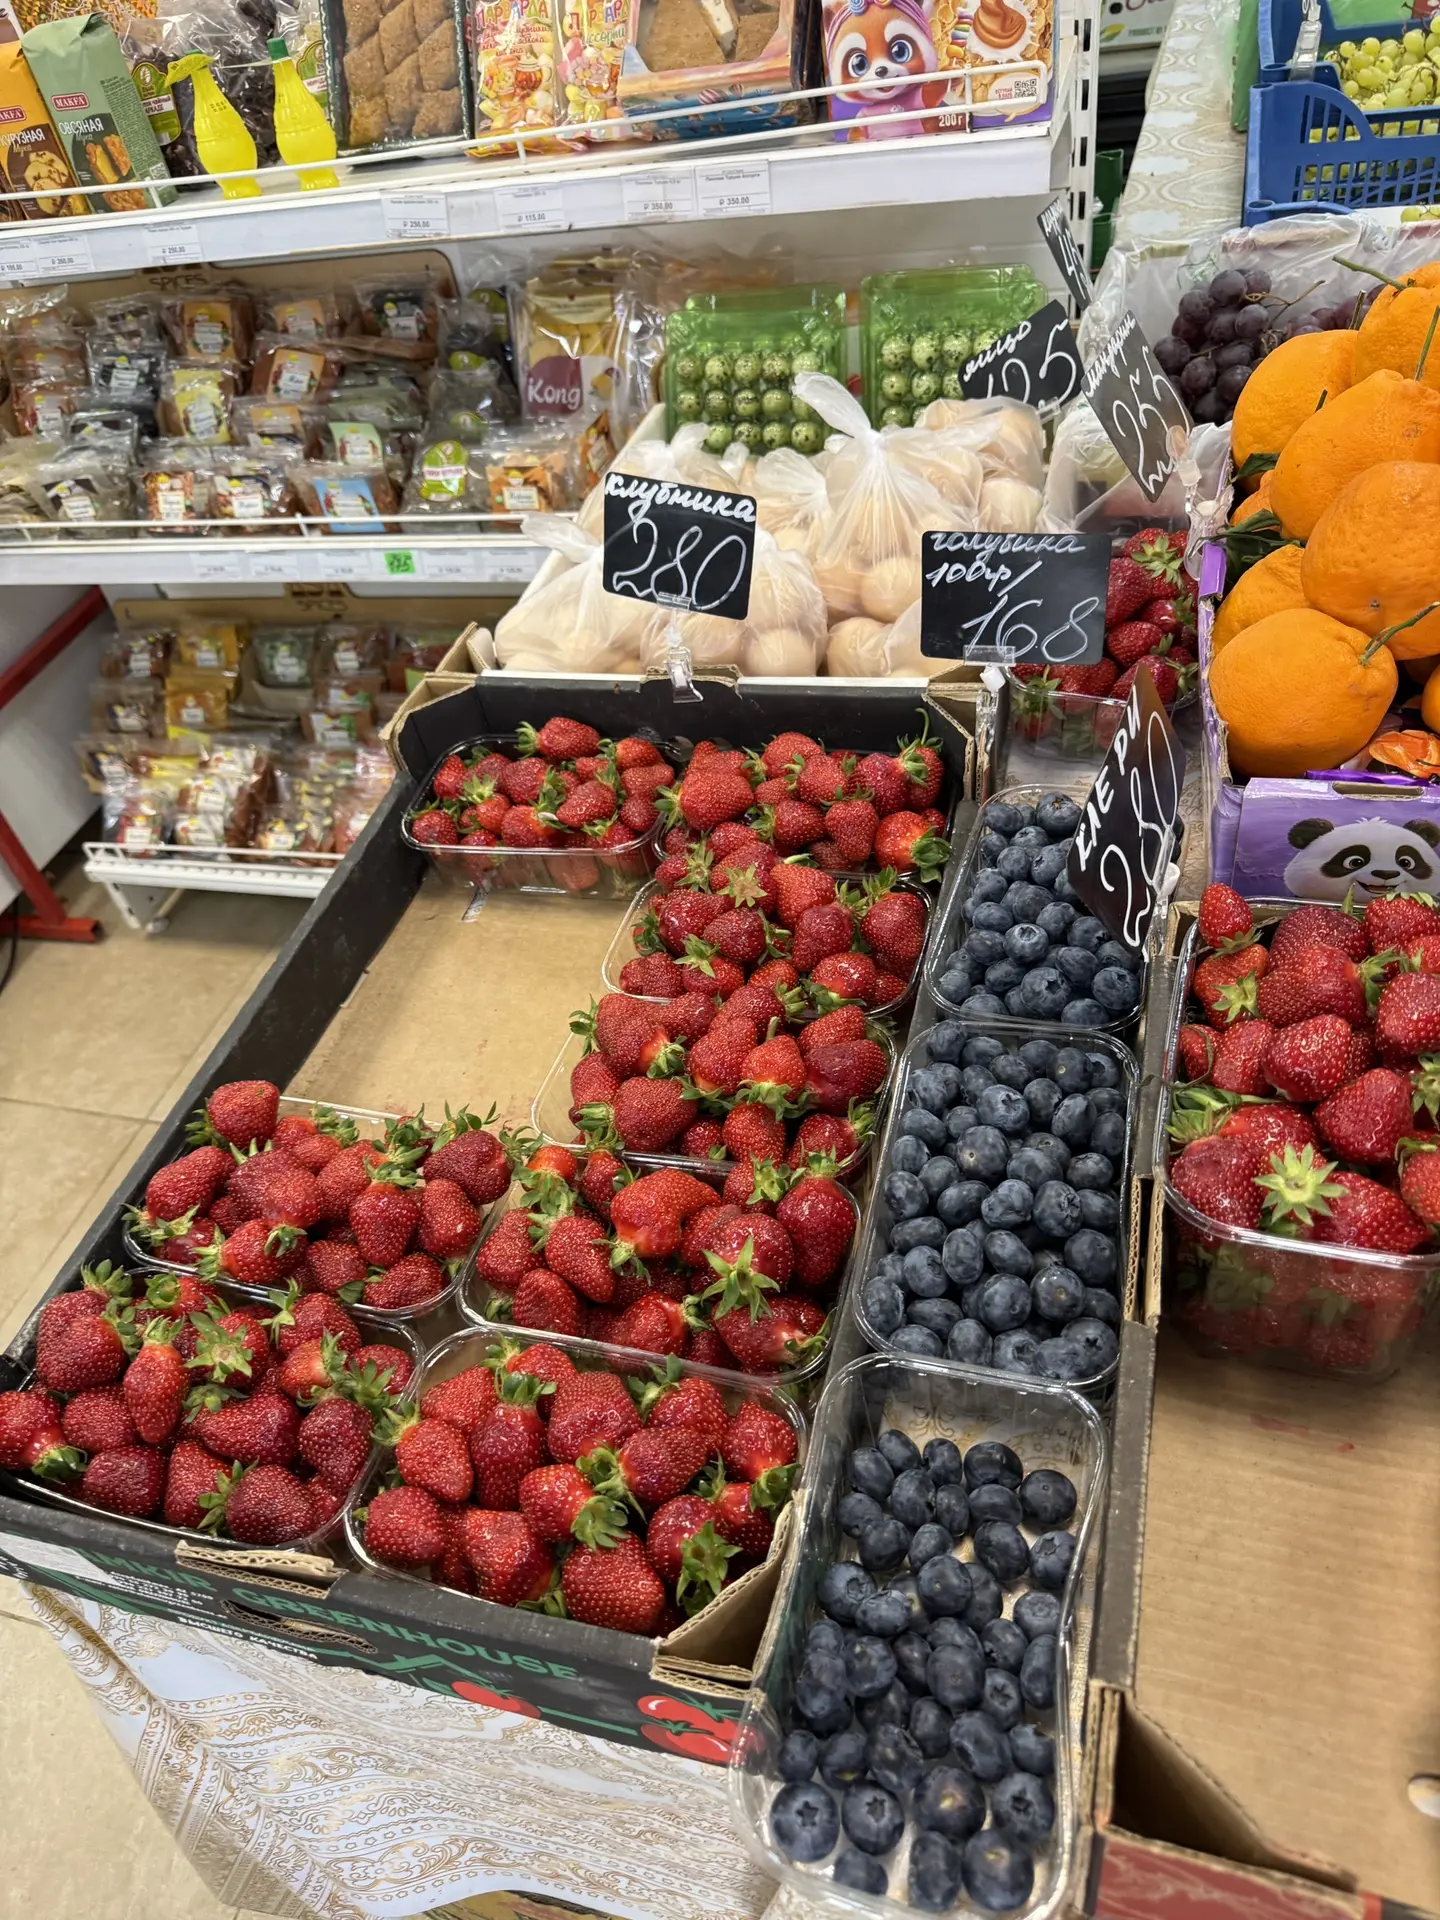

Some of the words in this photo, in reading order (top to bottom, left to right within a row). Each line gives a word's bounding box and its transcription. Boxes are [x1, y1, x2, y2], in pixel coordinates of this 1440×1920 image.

[55, 96, 86, 108] MAKFA
[58, 118, 104, 135] ОВСЯНАЯ
[612, 516, 747, 611] 280
[961, 594, 1100, 662] 168
[232, 1587, 578, 1680] GREENHOUSE
[249, 1635, 318, 1660] КАЧЕСТВА
